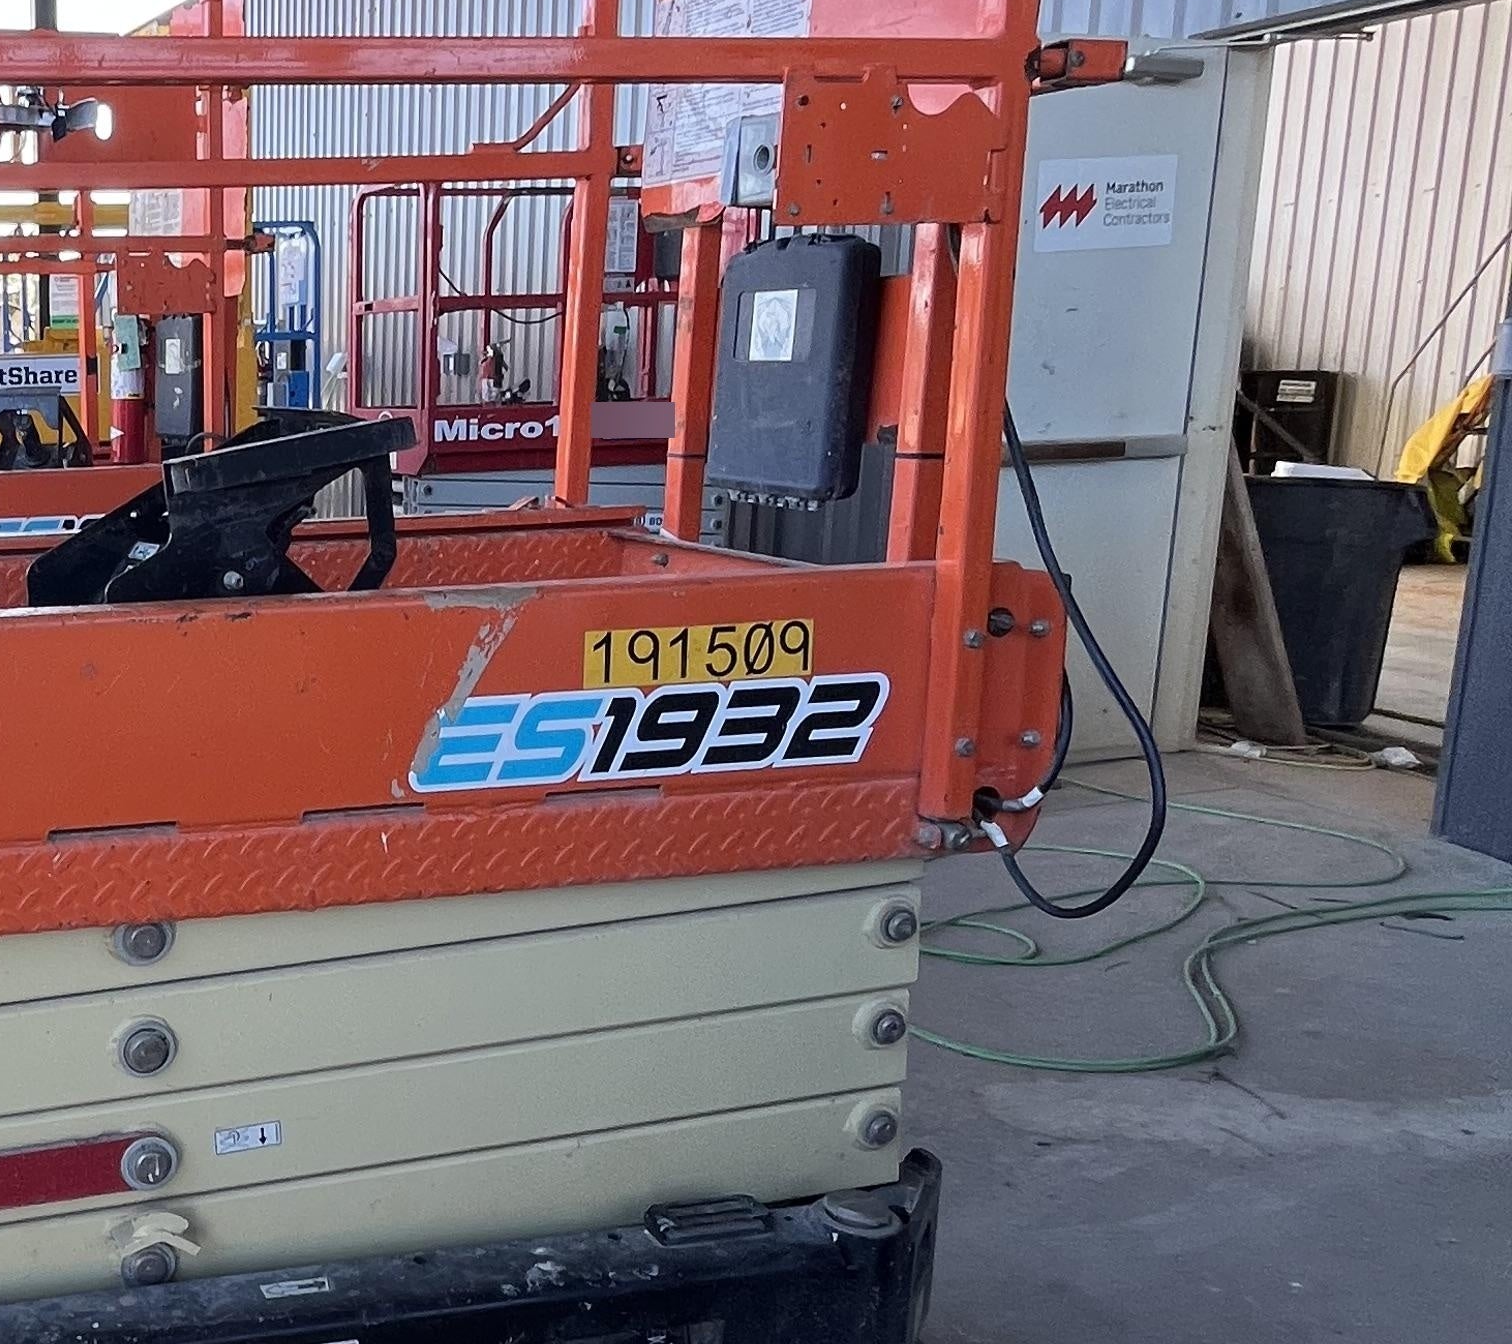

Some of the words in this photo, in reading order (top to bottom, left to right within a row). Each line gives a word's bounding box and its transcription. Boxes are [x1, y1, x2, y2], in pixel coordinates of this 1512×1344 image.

[1105, 180, 1164, 194] Marathon
[1104, 197, 1157, 211] Electrical
[1103, 213, 1171, 227] Contractors
[434, 415, 560, 442] Micro1
[592, 619, 810, 684] 191509
[410, 674, 887, 791] ES1932
